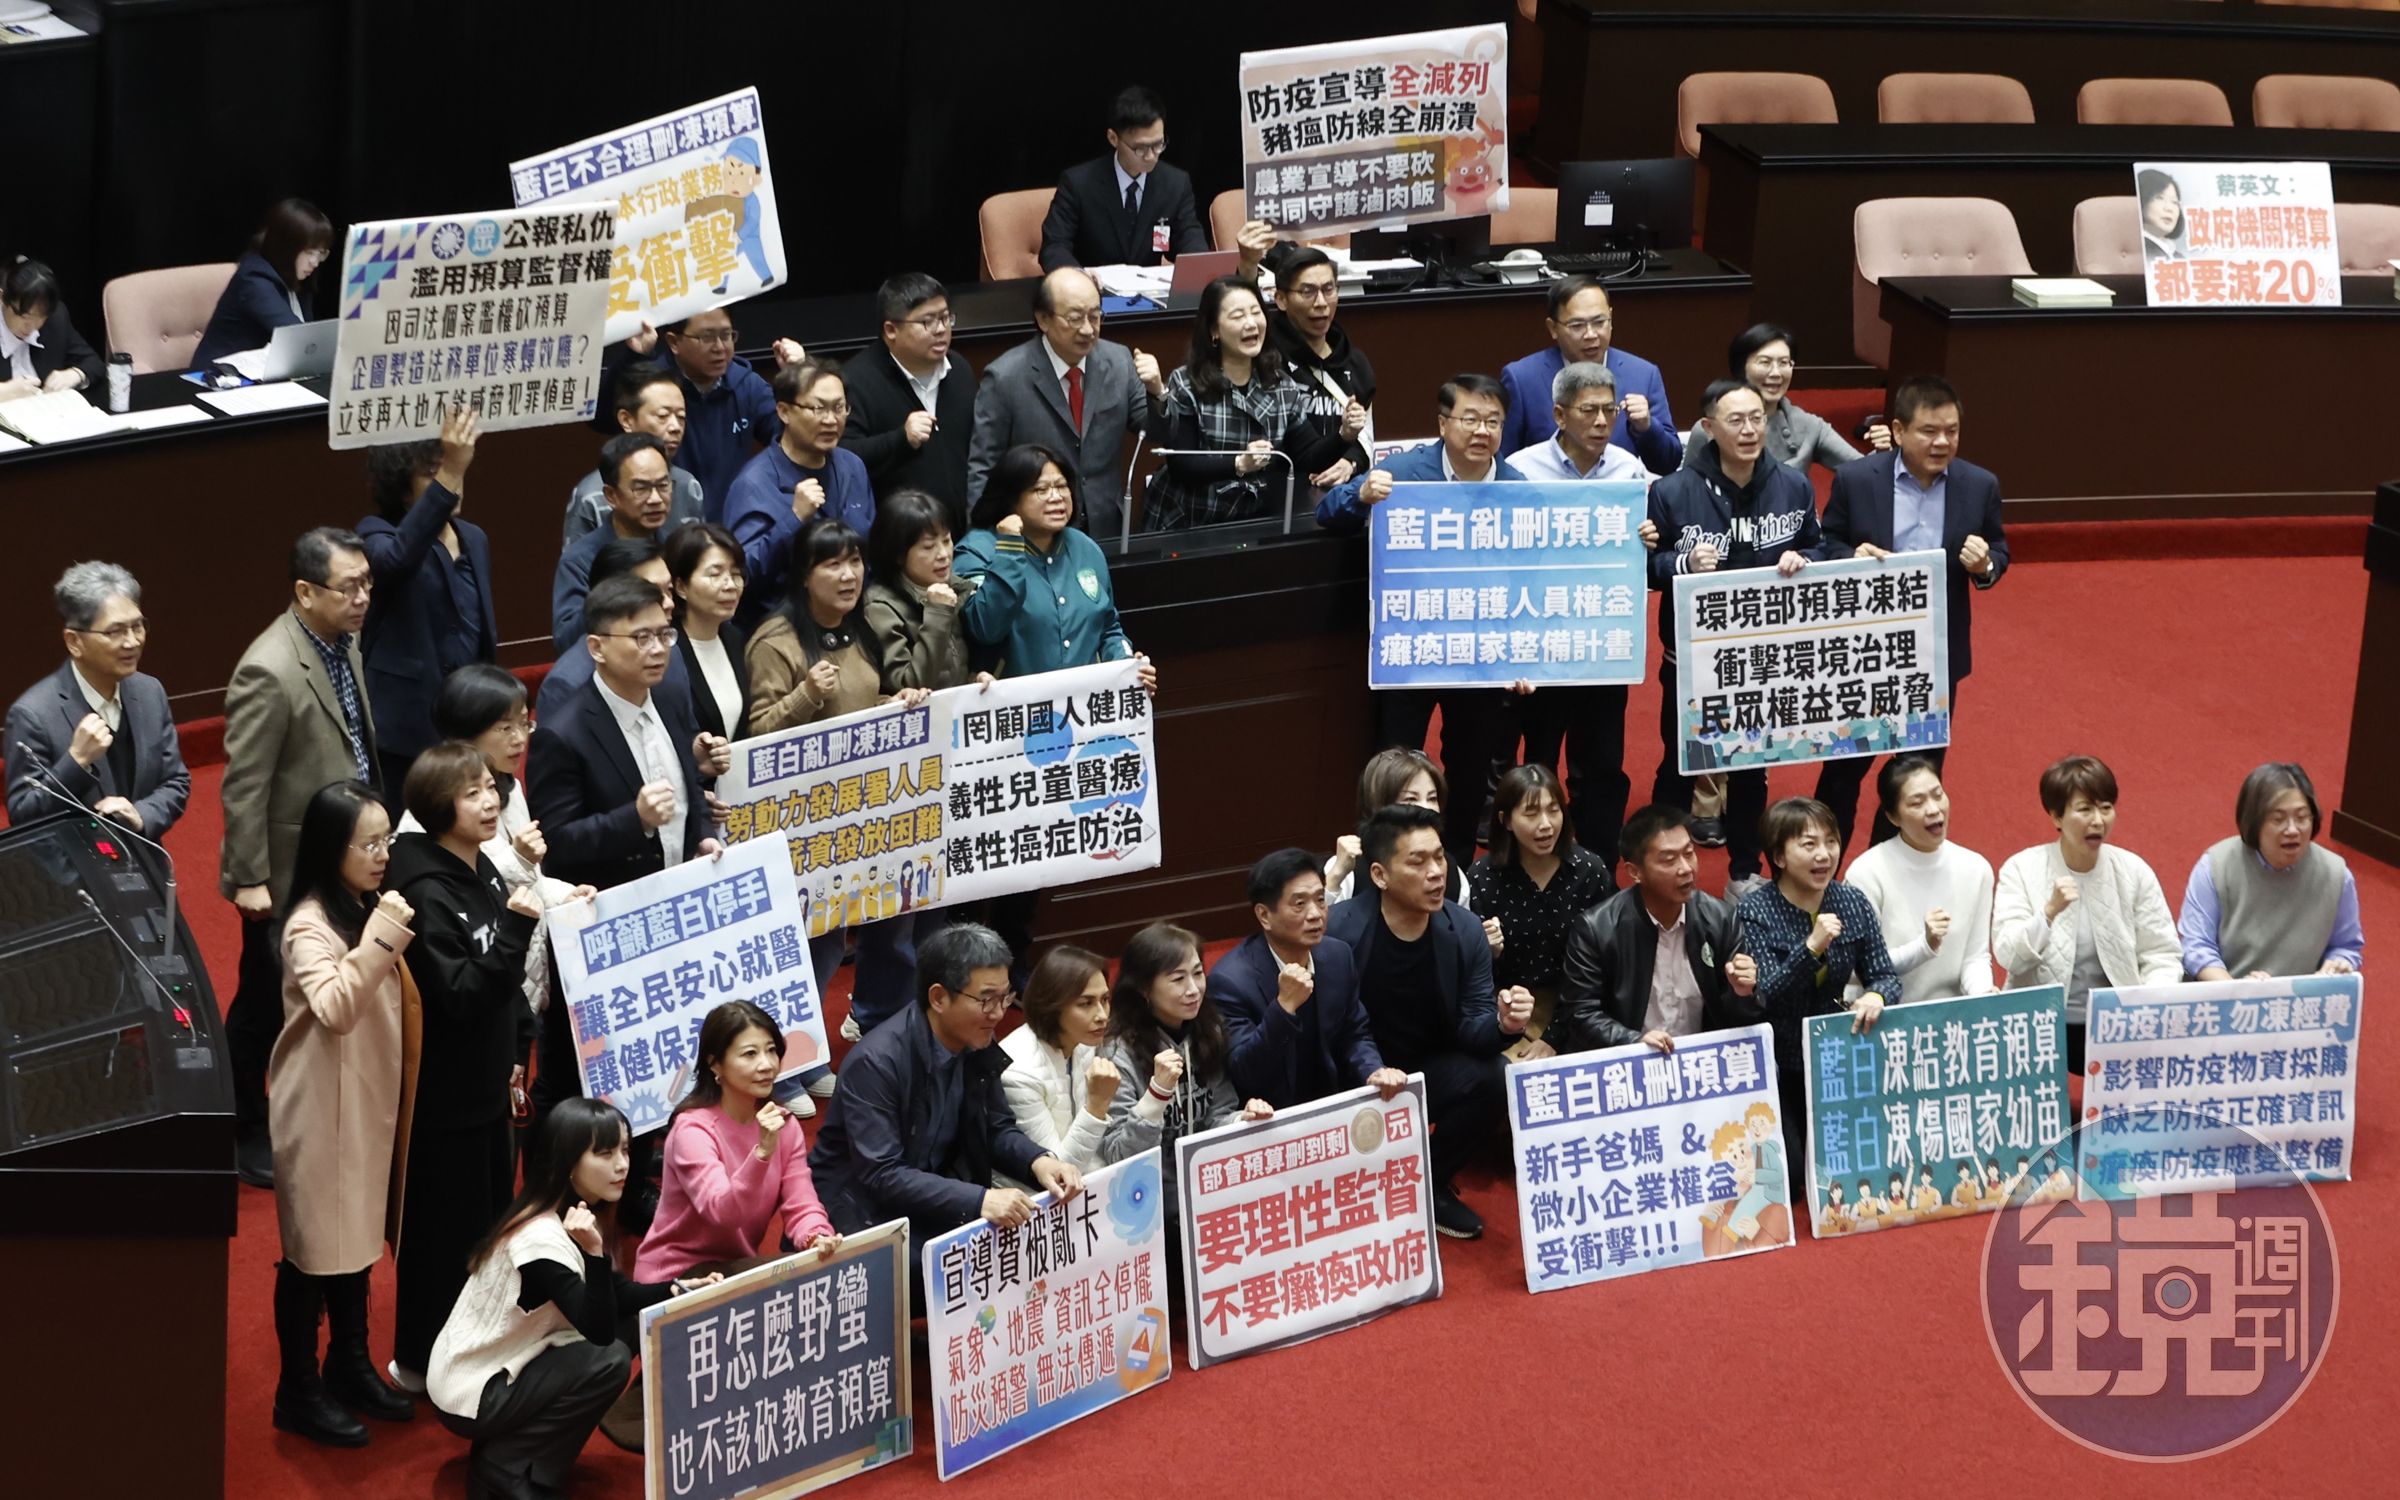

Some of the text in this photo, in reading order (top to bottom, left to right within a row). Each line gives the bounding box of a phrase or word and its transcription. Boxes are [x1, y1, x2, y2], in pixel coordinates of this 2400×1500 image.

[1247, 61, 1490, 124] 防疫宣導全減列
[513, 98, 757, 205] 藍白不合理刪凍預算
[1261, 101, 1478, 156] 豬瘟防線全崩潰
[606, 163, 723, 222] 本行政業務
[1253, 150, 1436, 197] 農業宣導不要砍
[1253, 180, 1436, 225] 共同守護滷肉飯
[503, 211, 616, 250] 公報私仇
[2186, 206, 2331, 250] 政府機關預算
[410, 249, 613, 299] 濫用預算監督權
[384, 292, 570, 345] 因司法個案濫權砍預算
[1386, 504, 1631, 552] 藍白亂刪預算
[1381, 584, 1634, 622] 罔顧醫護人員權益
[1695, 569, 1929, 632] 環境部預算凍結
[1380, 628, 1634, 667] 癱瘓國家整備計畫
[1713, 629, 1918, 690] 衝擊環境治理
[953, 685, 1147, 748] 罔顧國人健康
[1700, 671, 1934, 735] 民眾權益受威脅
[752, 711, 926, 783] 藍白亂刪凍預算
[724, 754, 944, 844] 勞動力發展署人員
[584, 872, 768, 969] 呼籲藍白停手
[573, 923, 803, 1045] 讓全民安心就醫
[2097, 994, 2351, 1043] 防疫優先 勿凍經費
[1522, 1041, 1761, 1124] 藍白亂刪預算
[1818, 1008, 2060, 1103] 藍白凍結教育預算
[2103, 1045, 2347, 1091] 影響防疫物資採購
[1821, 1080, 2061, 1176] 藍白凍傷國家幼苗
[2101, 1089, 2346, 1136] 缺乏防疫正確資訊
[1202, 1110, 1411, 1192] 部會預算刪到剩 元
[1525, 1122, 1706, 1185] 新手爸媽 &
[2099, 1137, 2343, 1185] 癱瘓防疫應變整備
[1197, 1154, 1422, 1274] 要理性監督
[1530, 1161, 1738, 1233] 微小企業權益
[942, 1189, 1100, 1315] 宣導費被亂卡
[1537, 1221, 1679, 1280] 受衝擊!!!
[1202, 1229, 1427, 1336] 不要癱瘓政府
[687, 1262, 868, 1408] 再怎麼野蠻
[947, 1252, 1153, 1387] 氣象、地震 資訊全停擺
[950, 1324, 1117, 1446] 防災預警 無法傳遞
[669, 1355, 892, 1495] 也不該砍教育預算
